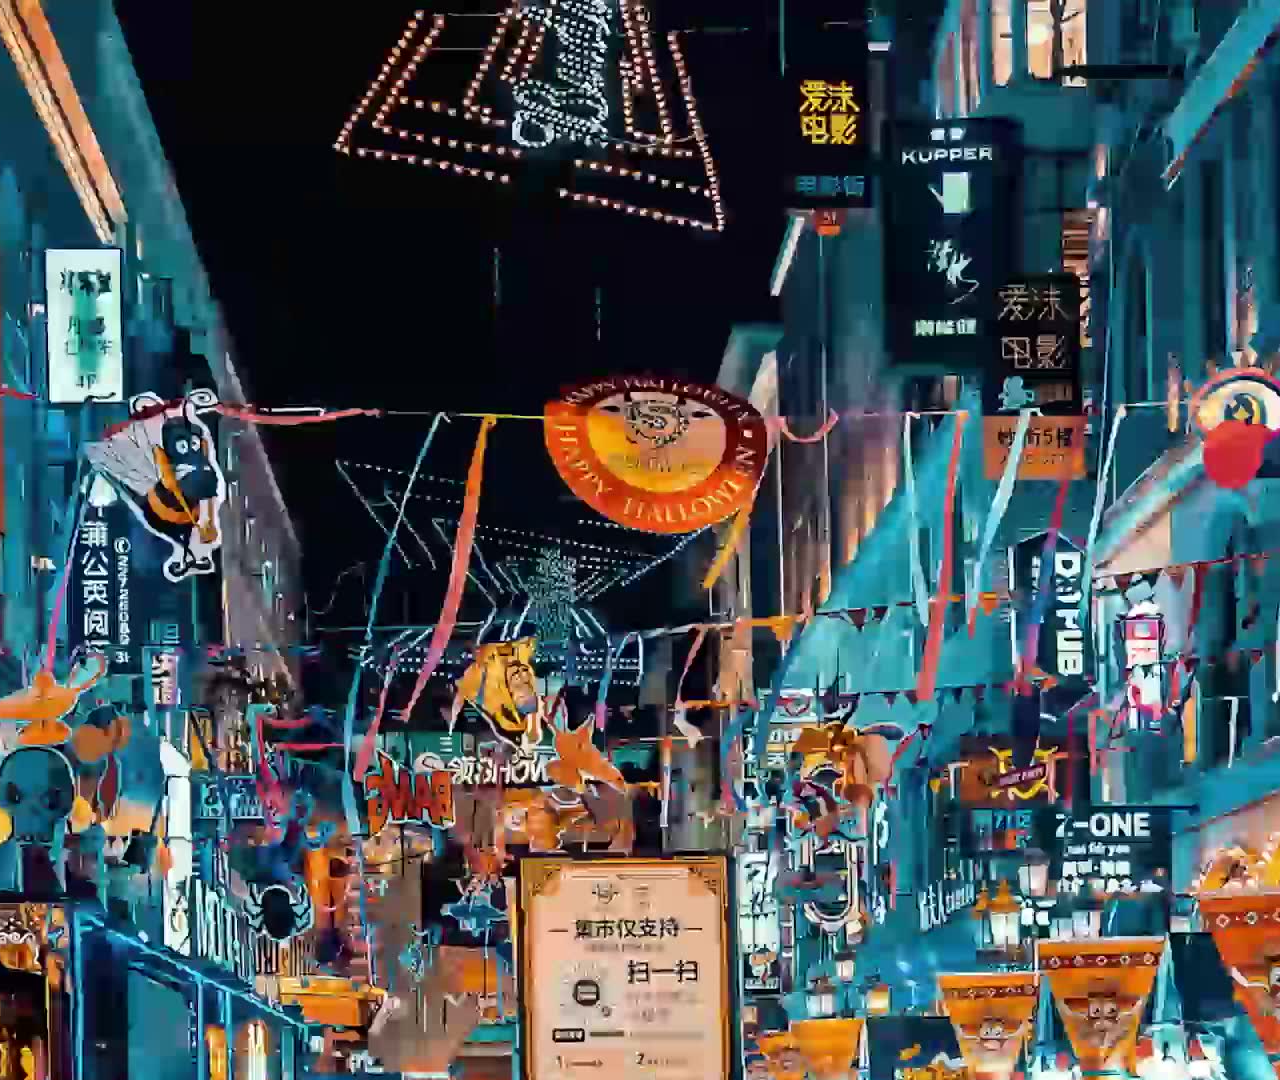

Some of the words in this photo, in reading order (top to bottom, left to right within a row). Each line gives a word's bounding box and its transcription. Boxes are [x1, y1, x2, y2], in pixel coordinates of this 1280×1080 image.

[802, 113, 858, 145] 电影
[901, 147, 993, 164] KUPPER
[626, 959, 700, 984] 扫一扫
